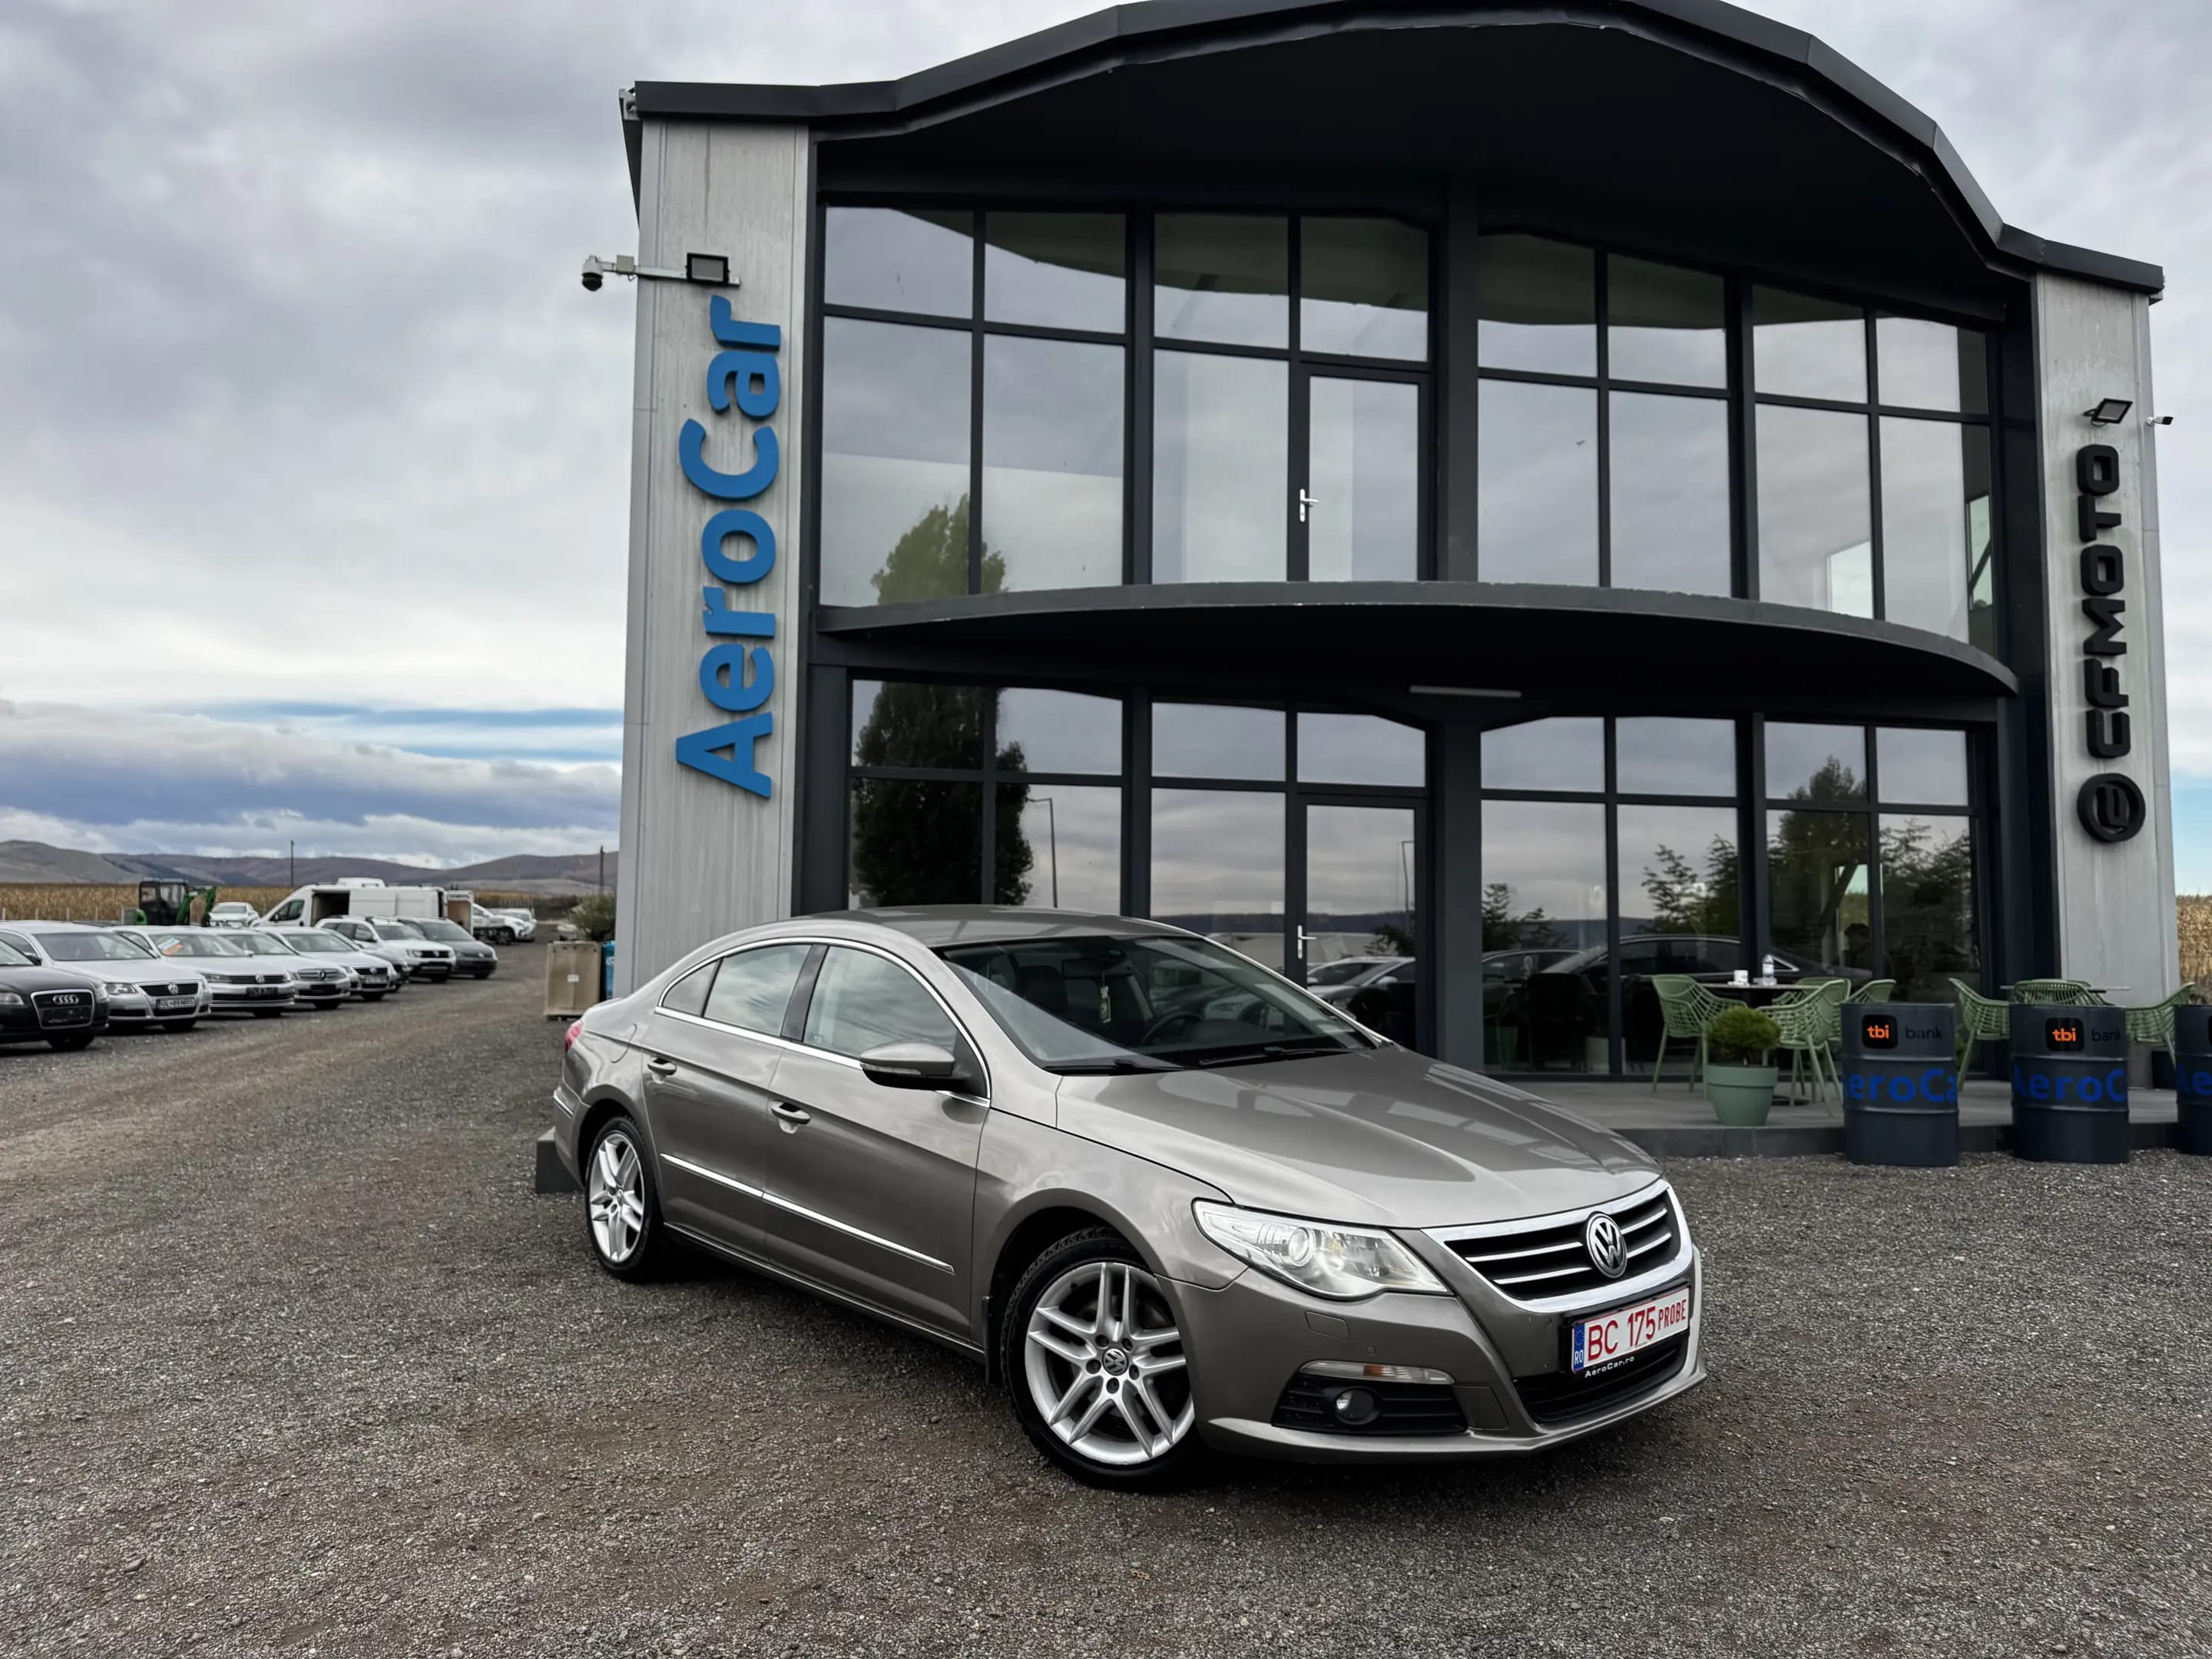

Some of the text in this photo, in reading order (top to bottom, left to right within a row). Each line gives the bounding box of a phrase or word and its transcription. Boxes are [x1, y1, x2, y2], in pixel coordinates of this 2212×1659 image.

[675, 295, 780, 800] AeroCar
[2077, 444, 2131, 758] CFMOTO
[1866, 1024, 1943, 1040] tbi bank
[2052, 1027, 2077, 1042] tbi
[1588, 1299, 1687, 1361] BC 175 PROBE
[1575, 1349, 1584, 1365] RO
[1584, 1355, 1634, 1378] AeroCar.ro
